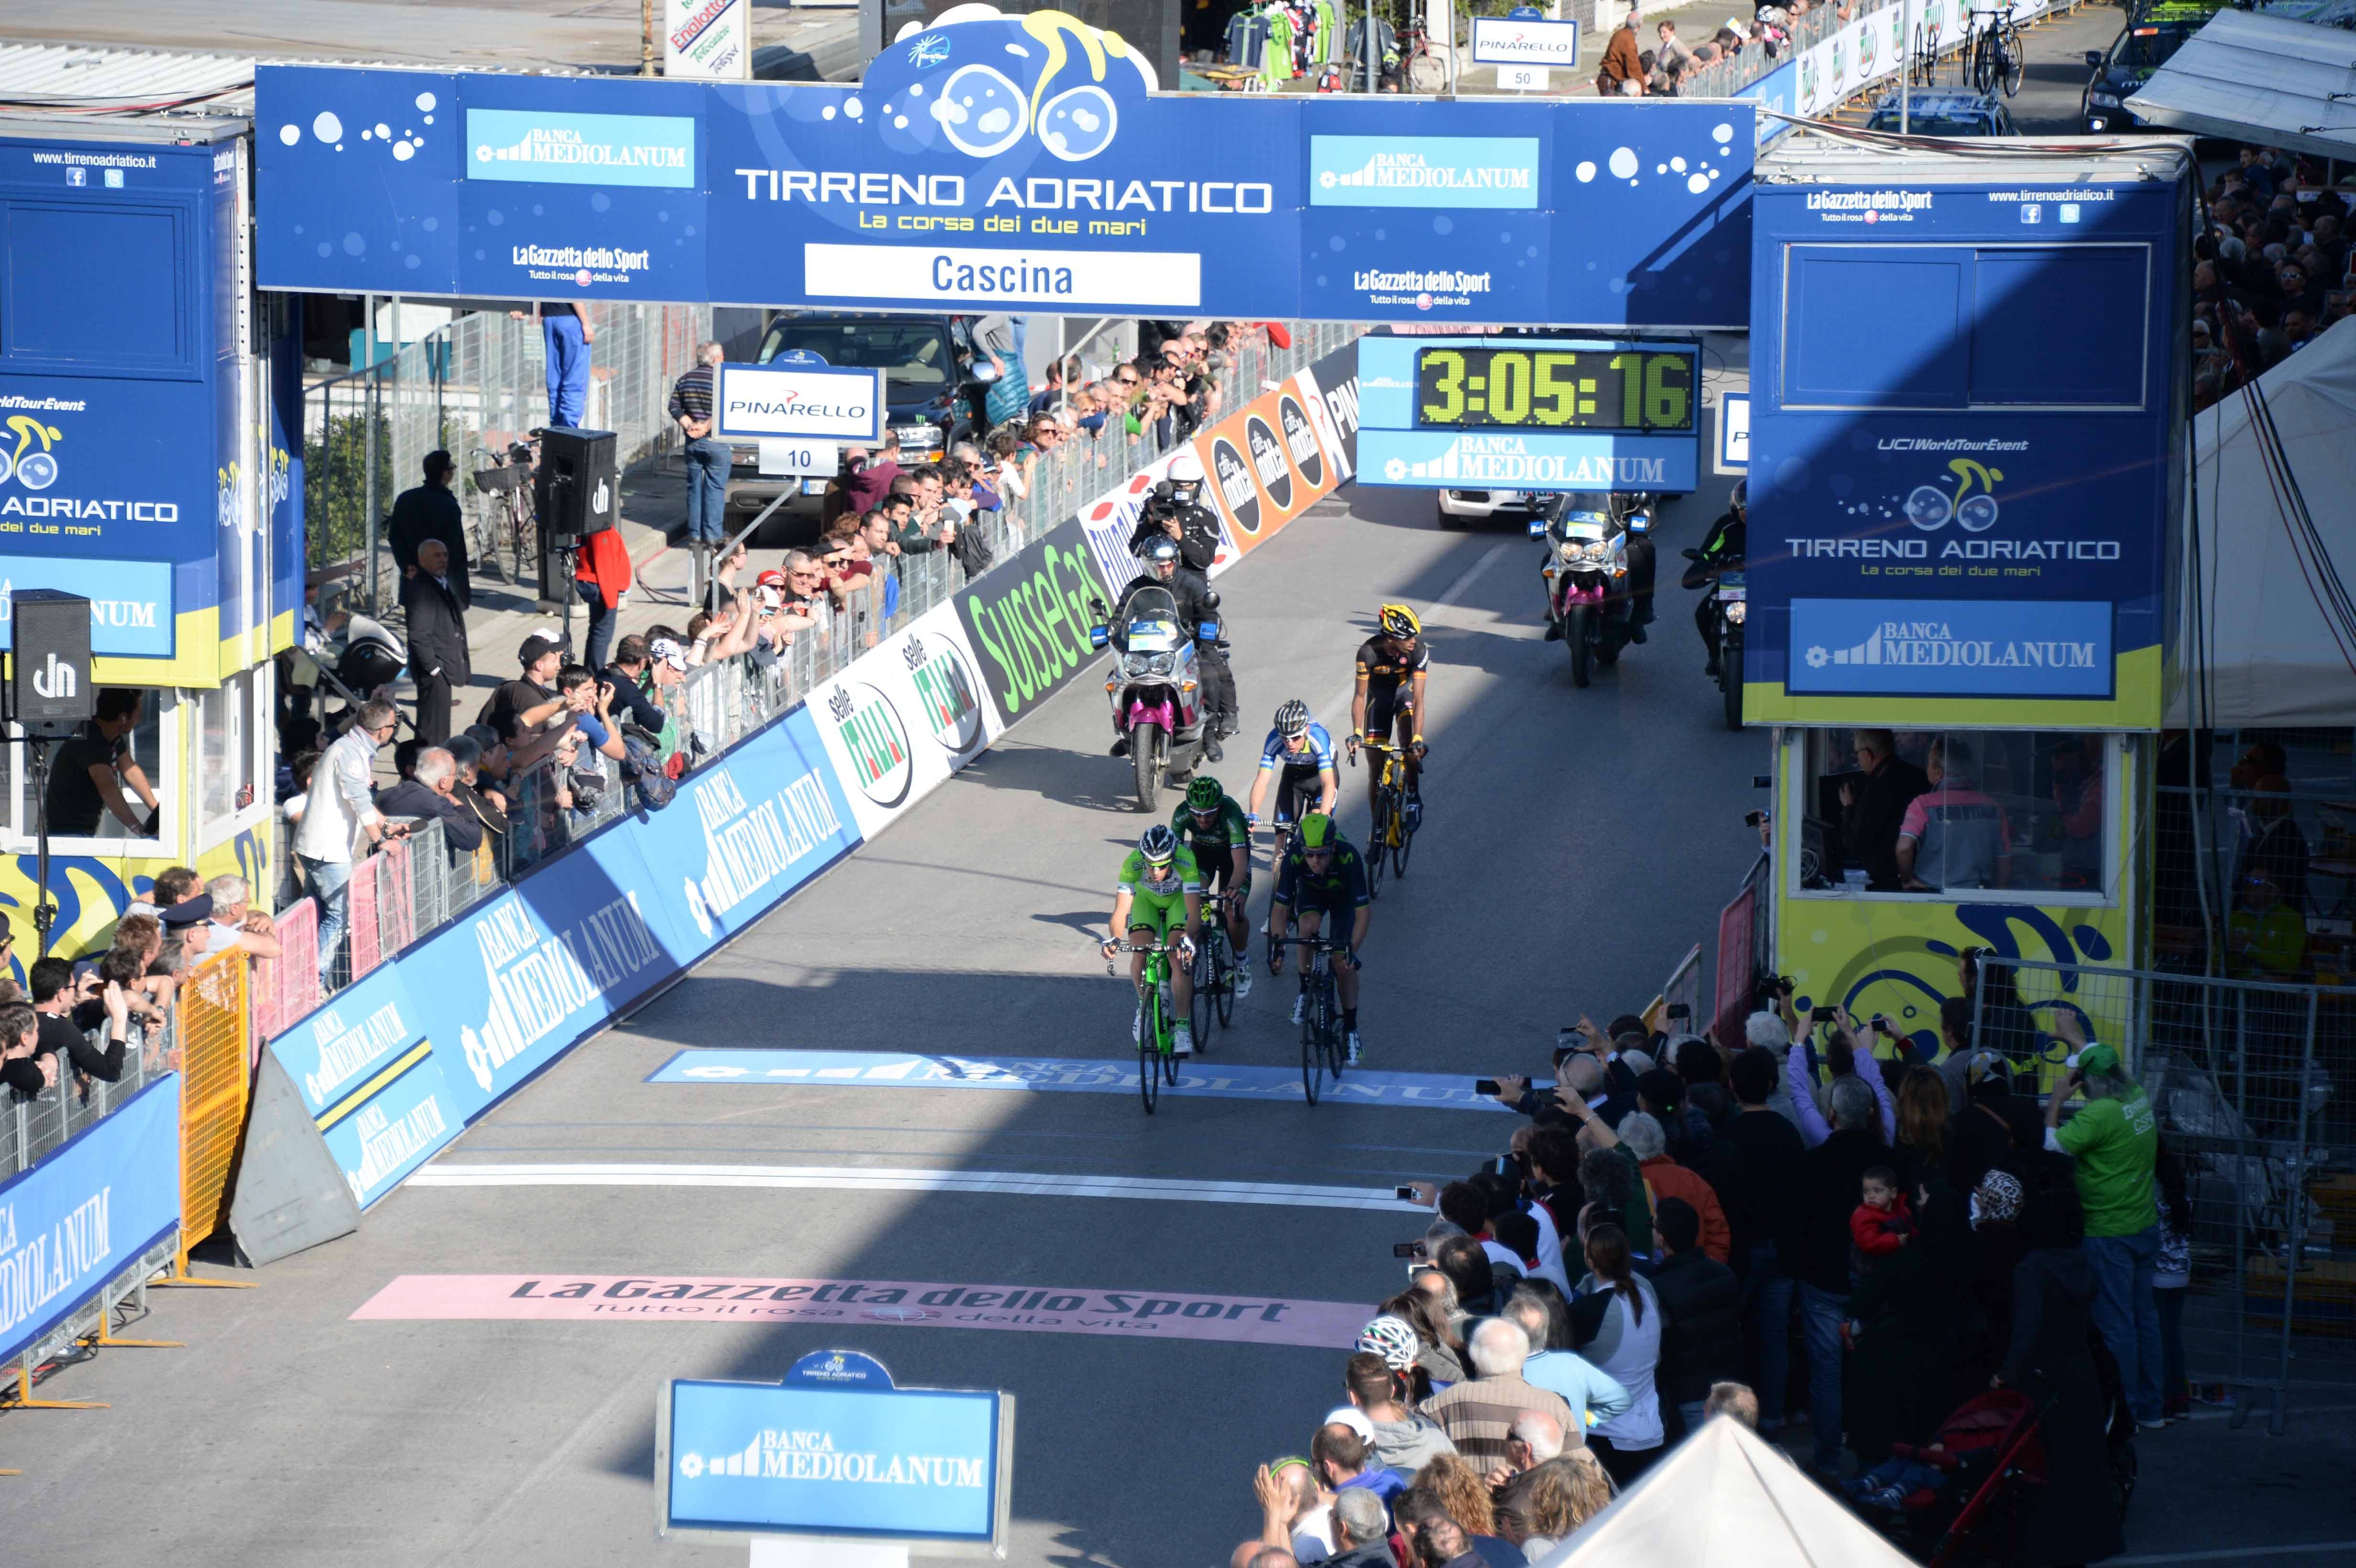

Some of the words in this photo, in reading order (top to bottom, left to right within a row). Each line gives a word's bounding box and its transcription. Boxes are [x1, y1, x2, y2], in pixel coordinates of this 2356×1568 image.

[1480, 41, 1568, 52] PINARELLO
[1515, 73, 1530, 84] 50
[533, 129, 583, 143] BANCA
[33, 152, 156, 169] www.tirrenoadriatico.it
[532, 142, 686, 168] MEDIOLANUM
[1377, 153, 1426, 167] BANCA
[1375, 167, 1530, 188] MEDIOLANUM
[735, 169, 965, 206] TIRRENO
[985, 177, 1273, 214] ADRIATICO
[1808, 192, 1821, 209] La
[1900, 190, 1932, 212] Sport
[1989, 189, 2114, 201] www.tirrenoadriatico.it
[859, 210, 887, 230] La
[898, 215, 974, 231] corsa
[984, 215, 1020, 233] dei
[1032, 216, 1079, 234] due
[1089, 218, 1146, 236] mari
[1821, 213, 1842, 221] Tutto
[1842, 213, 1847, 221] il
[1879, 213, 1898, 221] della
[1898, 213, 1913, 221] vita
[513, 245, 528, 265] La
[614, 249, 649, 272] Sport
[529, 270, 551, 280] Tutto
[551, 271, 557, 280] il
[557, 272, 575, 281] rosa
[592, 272, 612, 282] della
[613, 273, 629, 283] vita
[932, 255, 1073, 294] Cascina
[1354, 271, 1368, 291] La
[1455, 273, 1491, 296] Sport
[1370, 294, 1391, 305] Tutto
[1391, 295, 1396, 305] il
[1397, 296, 1416, 305] rosa
[1433, 296, 1452, 306] della
[1454, 296, 1470, 306] vita
[730, 401, 865, 418] PINARELLO
[1461, 436, 1527, 454] BANCA
[788, 450, 811, 467] 10
[1460, 452, 1665, 483] MEDIOLANUM
[1, 497, 178, 523] ADRIATICO
[0, 521, 23, 533] dei
[29, 522, 59, 534] due
[65, 525, 101, 536] mari
[1530, 524, 1544, 533] Rai
[1785, 538, 1928, 559] TIRRENO
[1941, 540, 2120, 560] ADRIATICO
[1862, 565, 1879, 575] La
[1885, 566, 1933, 576] corsa
[1939, 566, 1962, 576] dei
[1969, 566, 1998, 577] due
[2004, 566, 2041, 577] mari
[1884, 622, 1952, 640] BANCA
[903, 633, 927, 671] selle
[1883, 641, 2095, 668] MEDIOLANUM
[829, 684, 854, 722] selle
[912, 649, 976, 736] ITALIA
[839, 699, 906, 789] ITALIA
[697, 768, 747, 831] BANCA
[715, 768, 841, 901] MEDIOLANUM
[477, 898, 541, 969] BANCA
[500, 890, 660, 1045] MEDIOLANUM
[313, 1009, 346, 1045] BANCA
[325, 1001, 407, 1082] MEDIOLANUM
[924, 1055, 1124, 1074] BANCA
[357, 1104, 388, 1139] BANCA
[367, 1094, 446, 1179] MEDIOLANUM
[0, 1186, 111, 1335] DIOLANUM
[509, 1281, 596, 1299] La
[602, 1280, 909, 1304] Gazzetta
[917, 1287, 1086, 1312] dello
[1091, 1295, 1290, 1323] Sport
[588, 1304, 707, 1314] Tutto
[714, 1304, 738, 1315] il
[754, 1307, 843, 1318] rosa
[954, 1312, 1062, 1326] della
[1077, 1319, 1158, 1329] vita
[763, 1430, 834, 1452] BANCA
[763, 1450, 983, 1487] MEDIOLANUM
